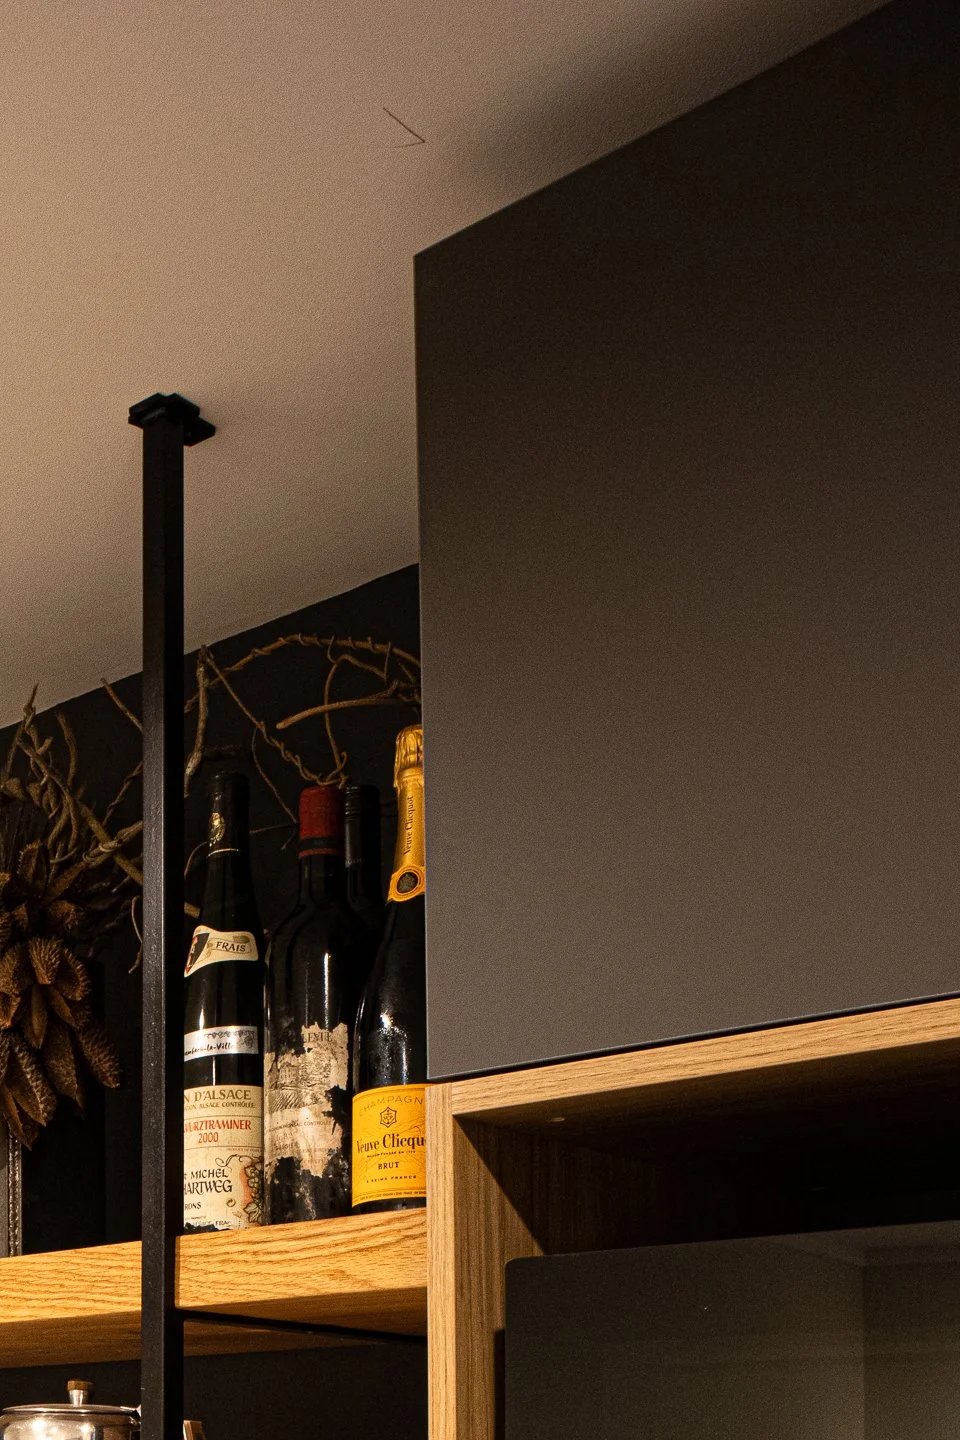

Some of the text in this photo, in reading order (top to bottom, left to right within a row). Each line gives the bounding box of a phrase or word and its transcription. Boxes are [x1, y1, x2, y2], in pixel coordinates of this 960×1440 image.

[403, 796, 415, 856] Veuve Clicquot
[215, 941, 246, 953] FRAIS
[194, 1089, 252, 1102] D'ALSACE
[198, 1131, 220, 1144] 2000
[356, 1139, 380, 1154] Veuve
[382, 1132, 427, 1150] Clicqu
[378, 1161, 400, 1170] BRUT
[190, 1167, 229, 1180] MICHEL
